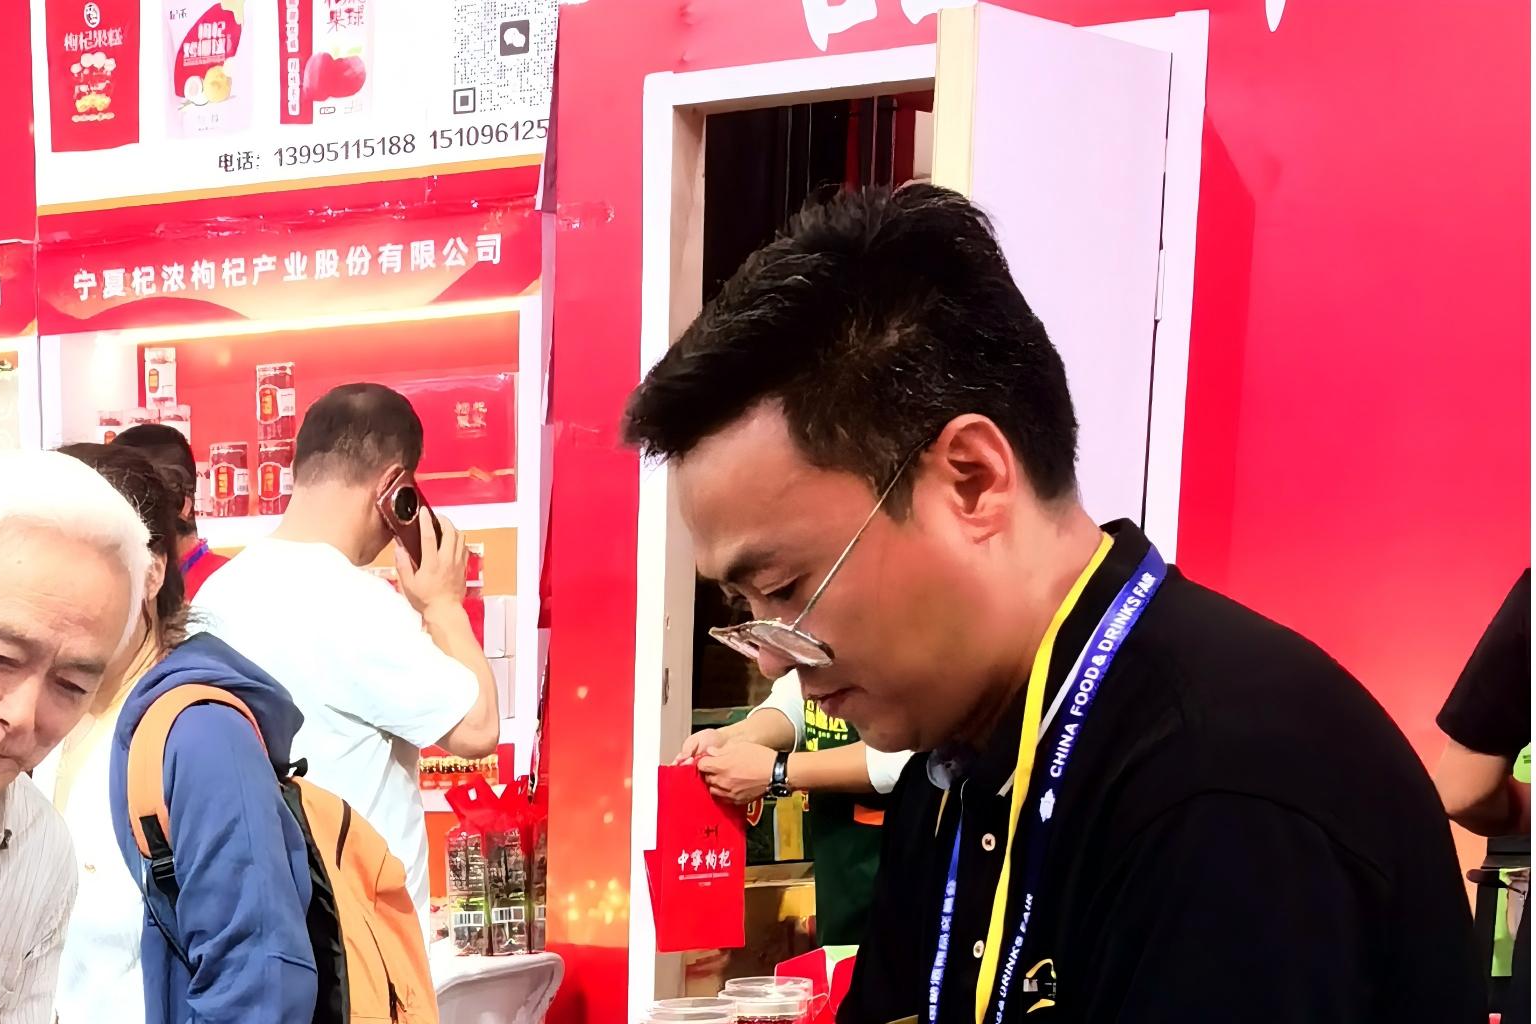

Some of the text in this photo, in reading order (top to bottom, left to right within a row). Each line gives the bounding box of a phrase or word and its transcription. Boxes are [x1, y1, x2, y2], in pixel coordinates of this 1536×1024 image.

[273, 133, 416, 168] 13995115188
[72, 233, 503, 302] 宁夏杞浓枸杞产业股份有限公司
[1050, 722, 1080, 778] CHINA
[1070, 666, 1101, 717] FOOD
[1097, 597, 1142, 652] DRINKS
[1131, 571, 1157, 599] FAIR
